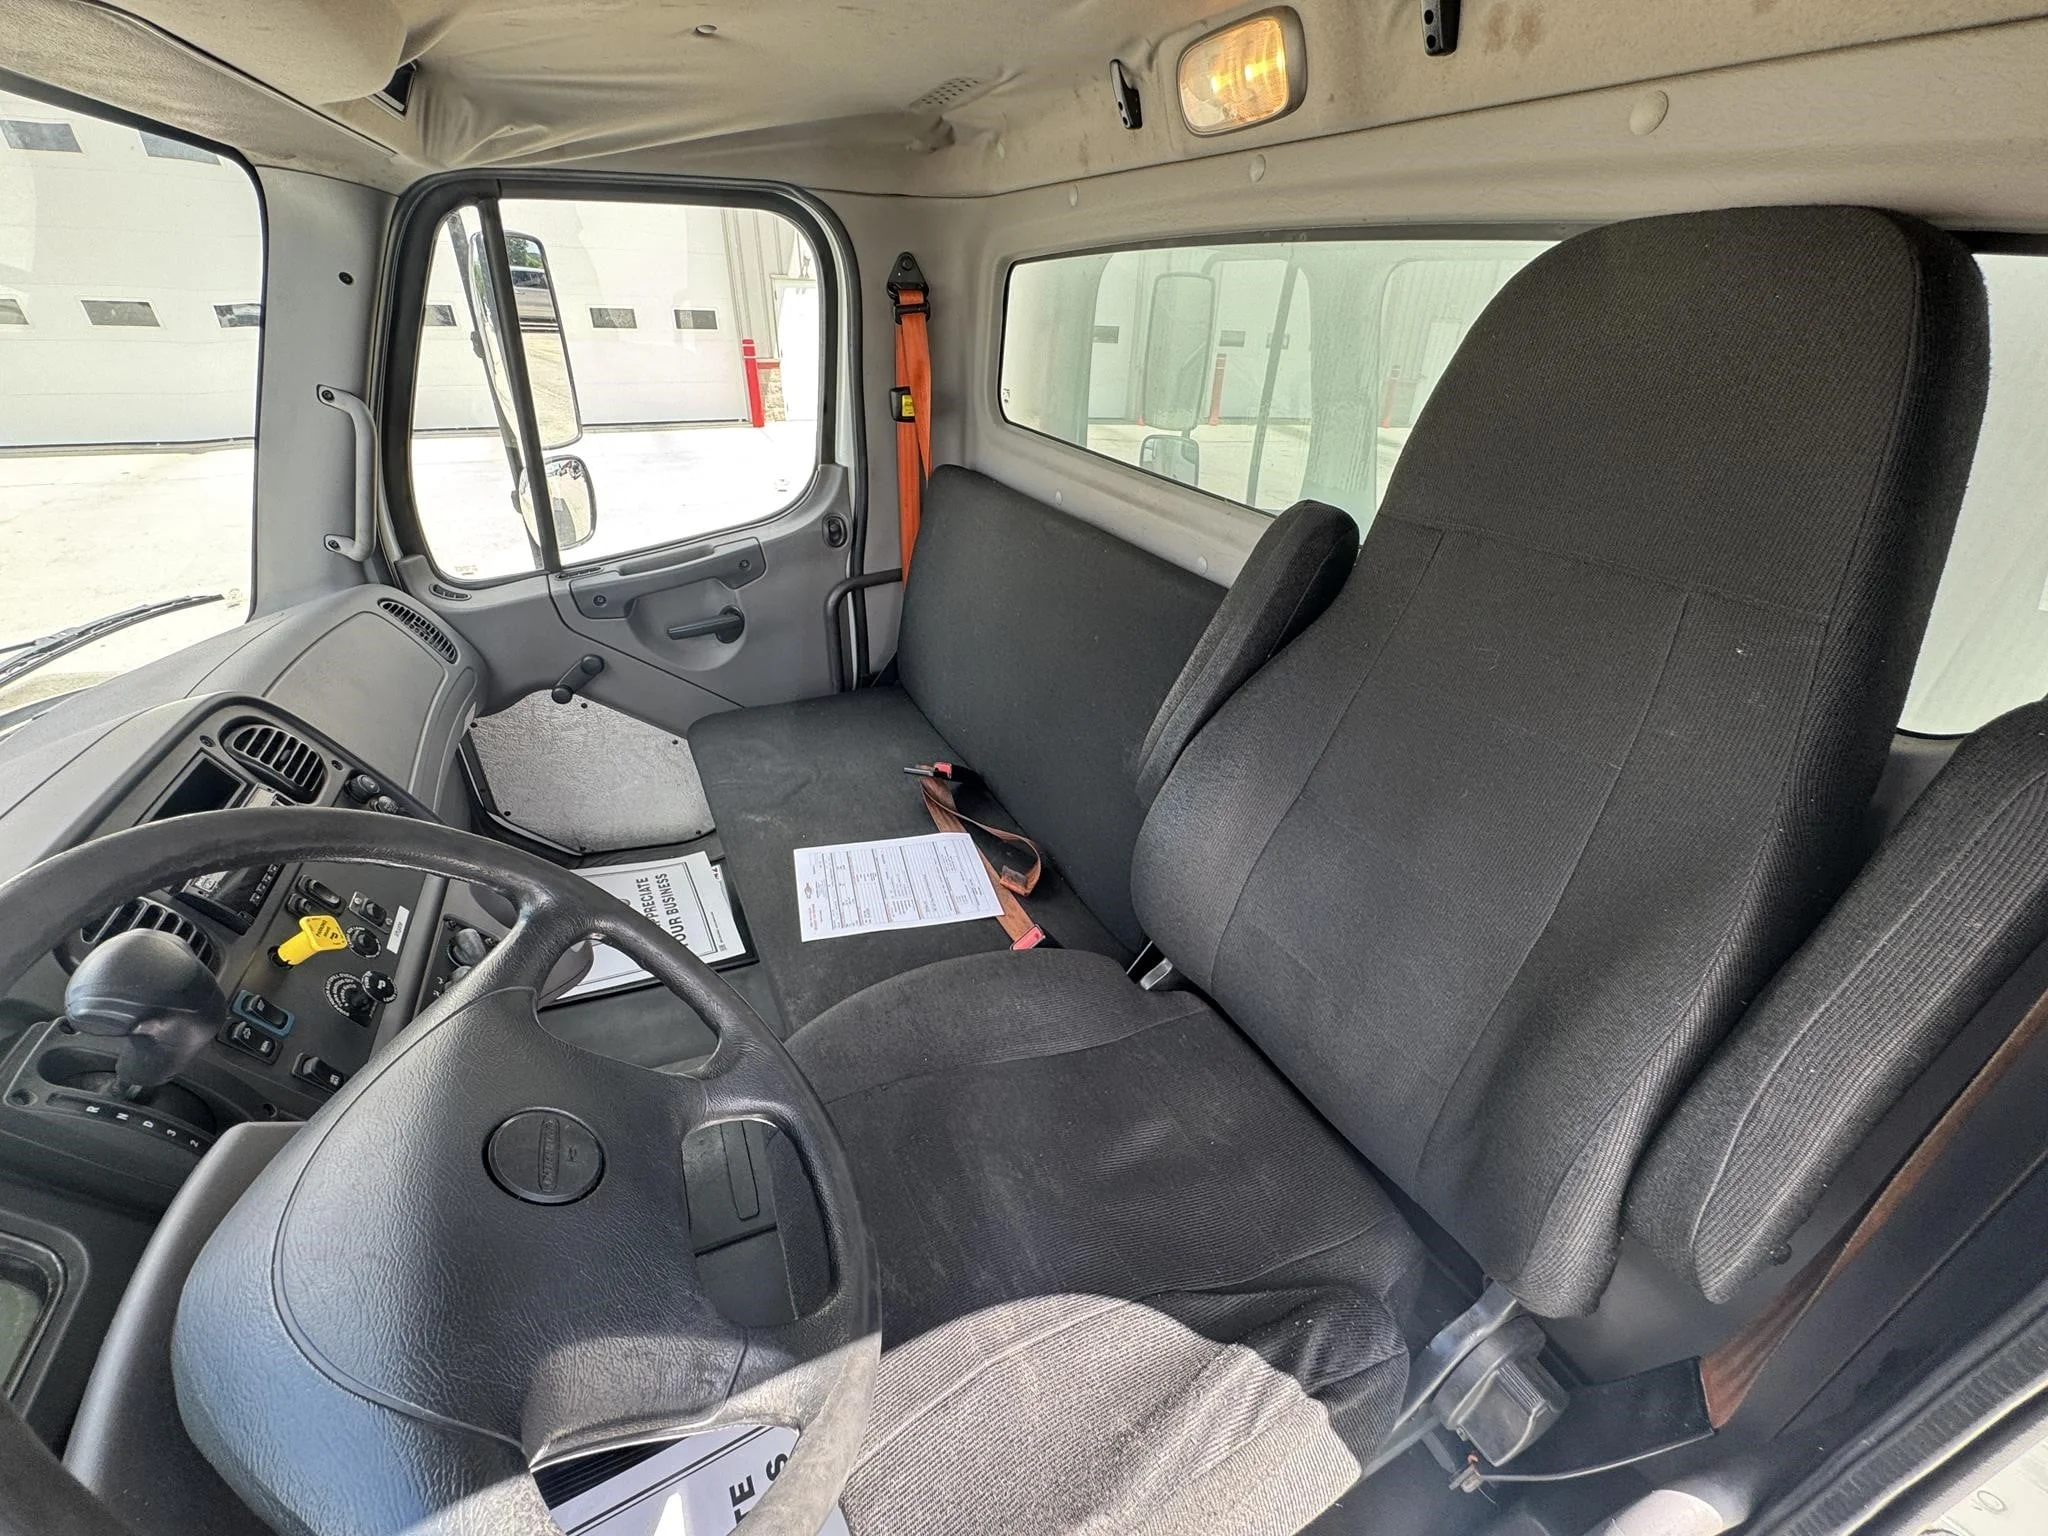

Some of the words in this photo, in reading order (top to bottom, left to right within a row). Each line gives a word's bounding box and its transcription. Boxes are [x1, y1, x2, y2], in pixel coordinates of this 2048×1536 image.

[635, 876, 661, 927] PPRECIATE
[655, 873, 680, 916] BUSINESS
[668, 916, 690, 947] OUR
[85, 1105, 100, 1114] R
[116, 1112, 129, 1121] N
[142, 1120, 154, 1129] D
[166, 1129, 177, 1137] 3
[189, 1139, 199, 1148] 2
